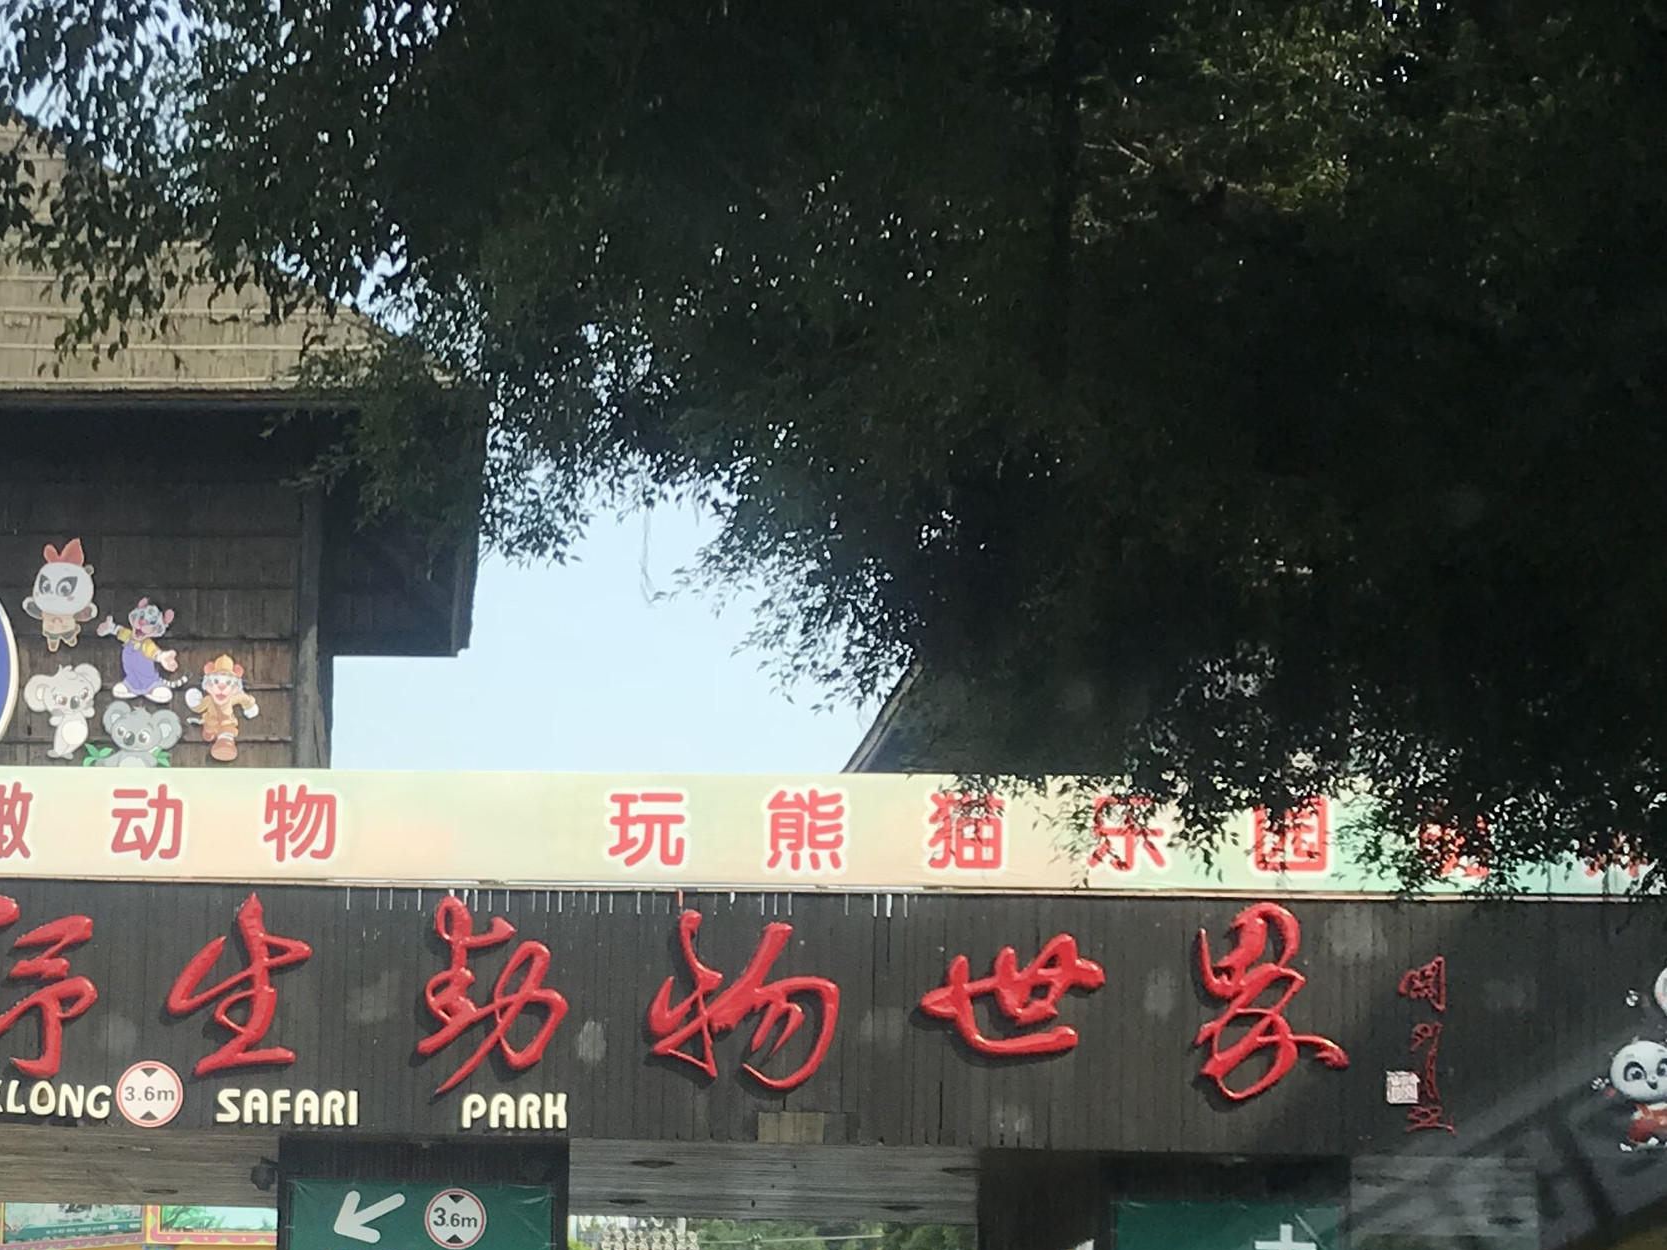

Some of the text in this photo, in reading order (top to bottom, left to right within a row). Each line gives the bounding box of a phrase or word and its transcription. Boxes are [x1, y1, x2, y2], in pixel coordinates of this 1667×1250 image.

[124, 1085, 176, 1104] 3.6m
[216, 1088, 359, 1126] SAFARI
[461, 1092, 568, 1129] PARK
[433, 1207, 479, 1229] 3.6m
